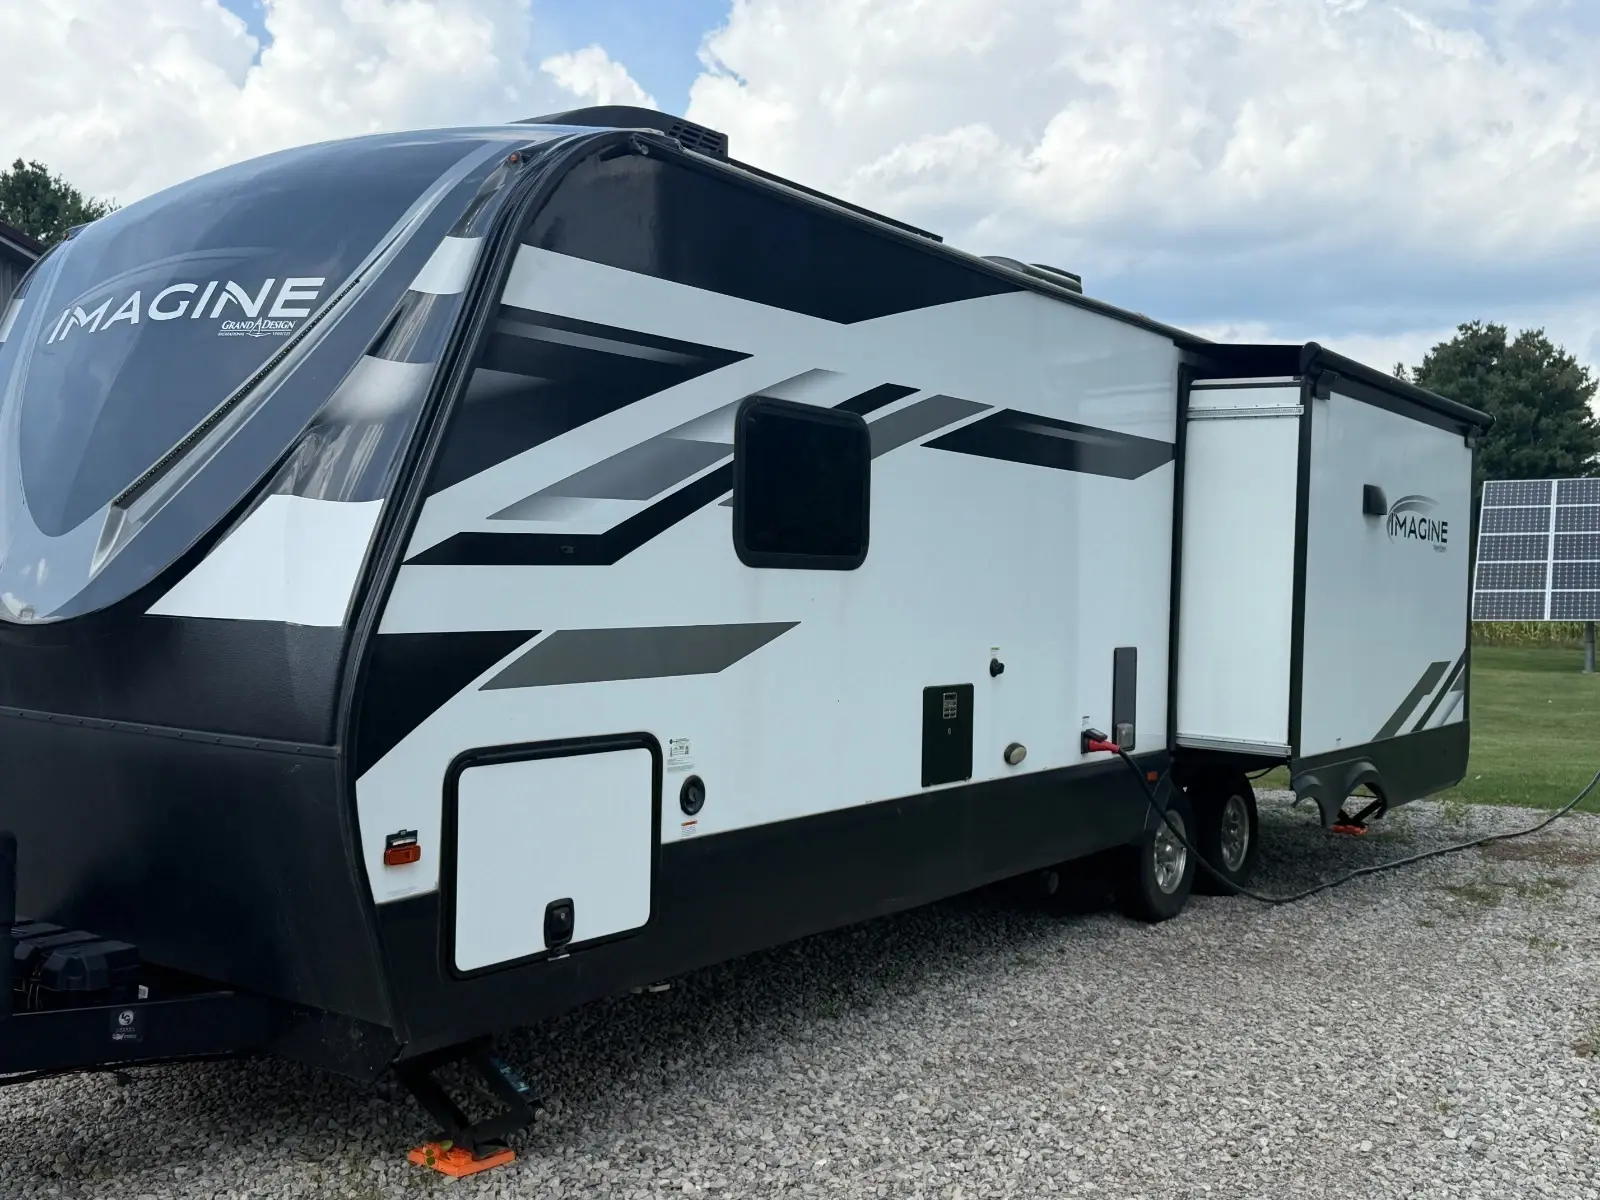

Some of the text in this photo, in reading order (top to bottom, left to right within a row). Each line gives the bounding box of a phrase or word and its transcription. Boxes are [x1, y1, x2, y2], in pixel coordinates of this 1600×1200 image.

[47, 277, 325, 344] IMAGINE
[221, 320, 296, 329] GRAND DESIGN
[1390, 512, 1448, 543] IMAGINE
